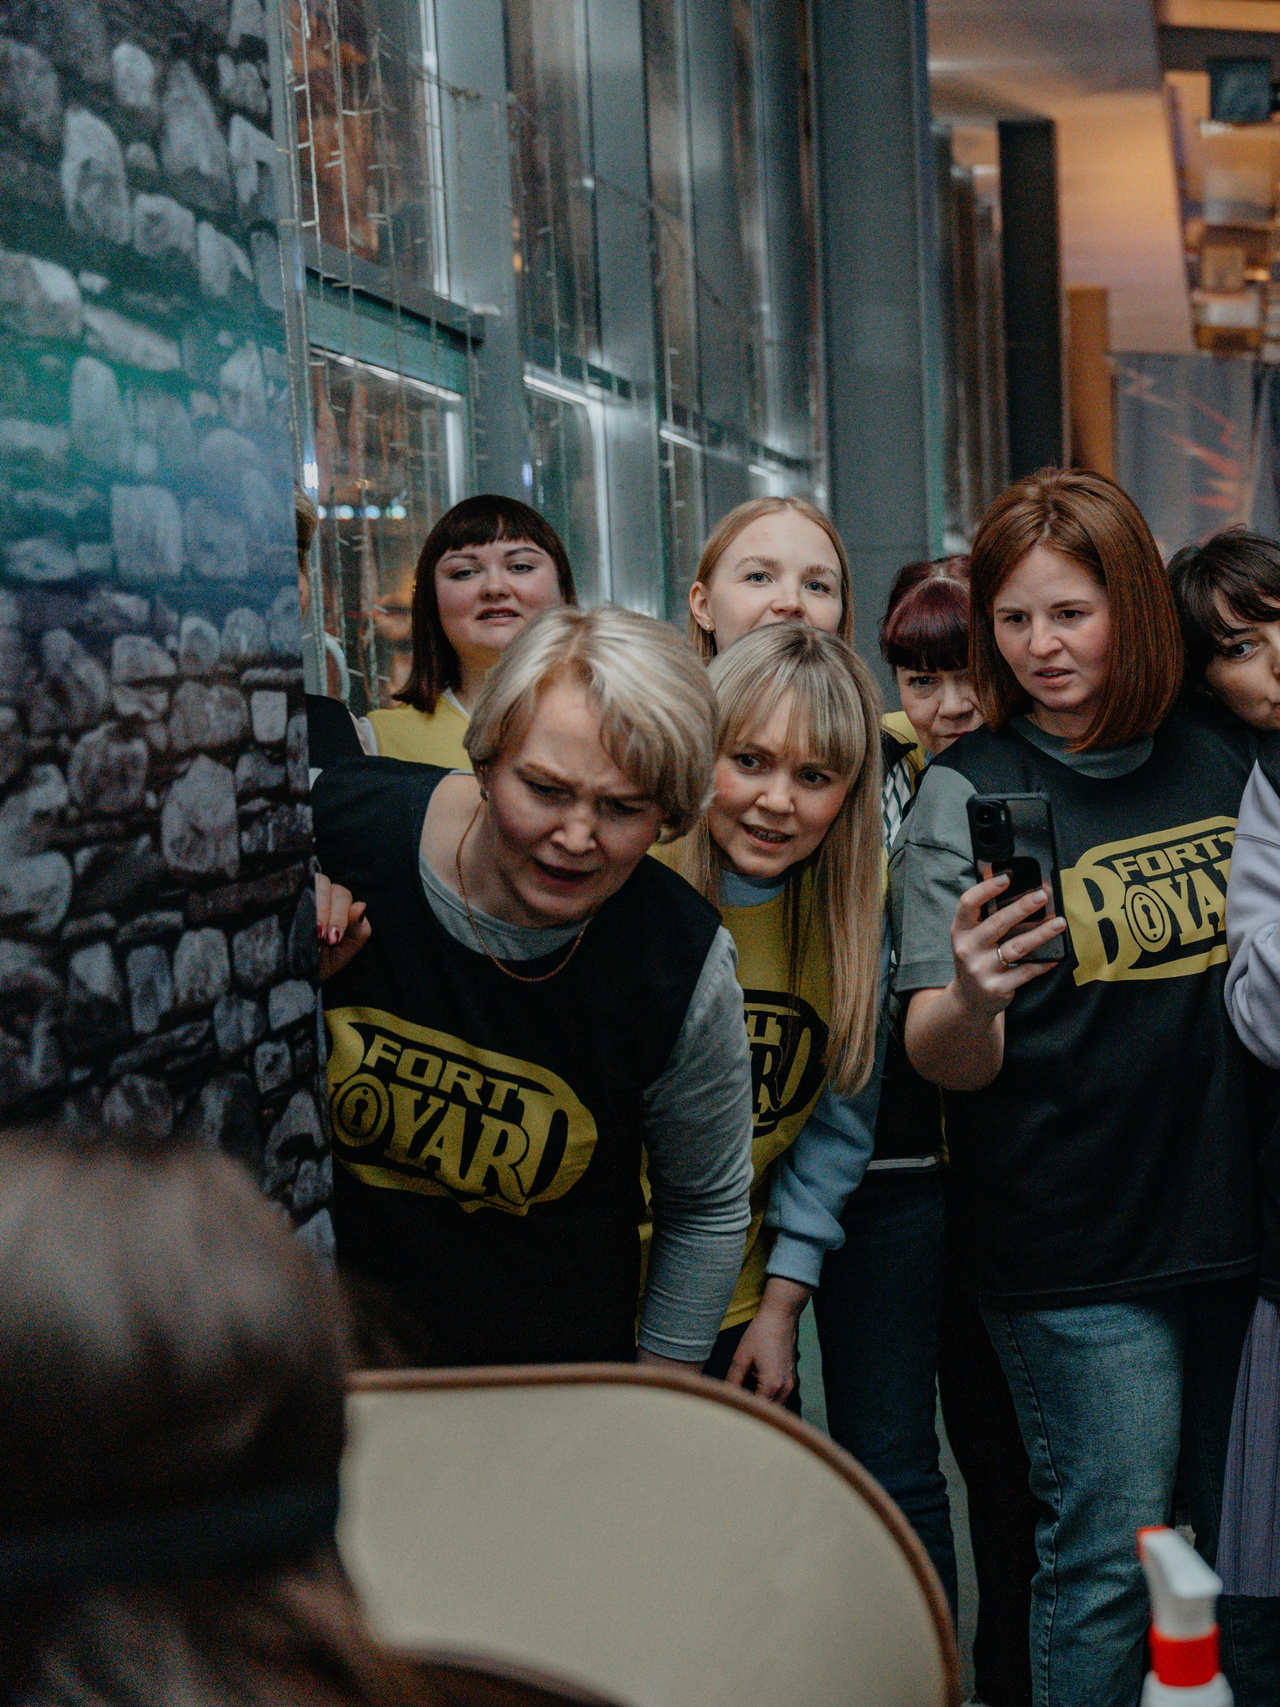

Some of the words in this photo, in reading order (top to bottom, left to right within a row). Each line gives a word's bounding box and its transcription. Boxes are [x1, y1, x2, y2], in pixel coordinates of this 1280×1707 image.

[1112, 834, 1221, 882] FORT
[1060, 856, 1238, 987] BOYA
[361, 1034, 520, 1113] FORT
